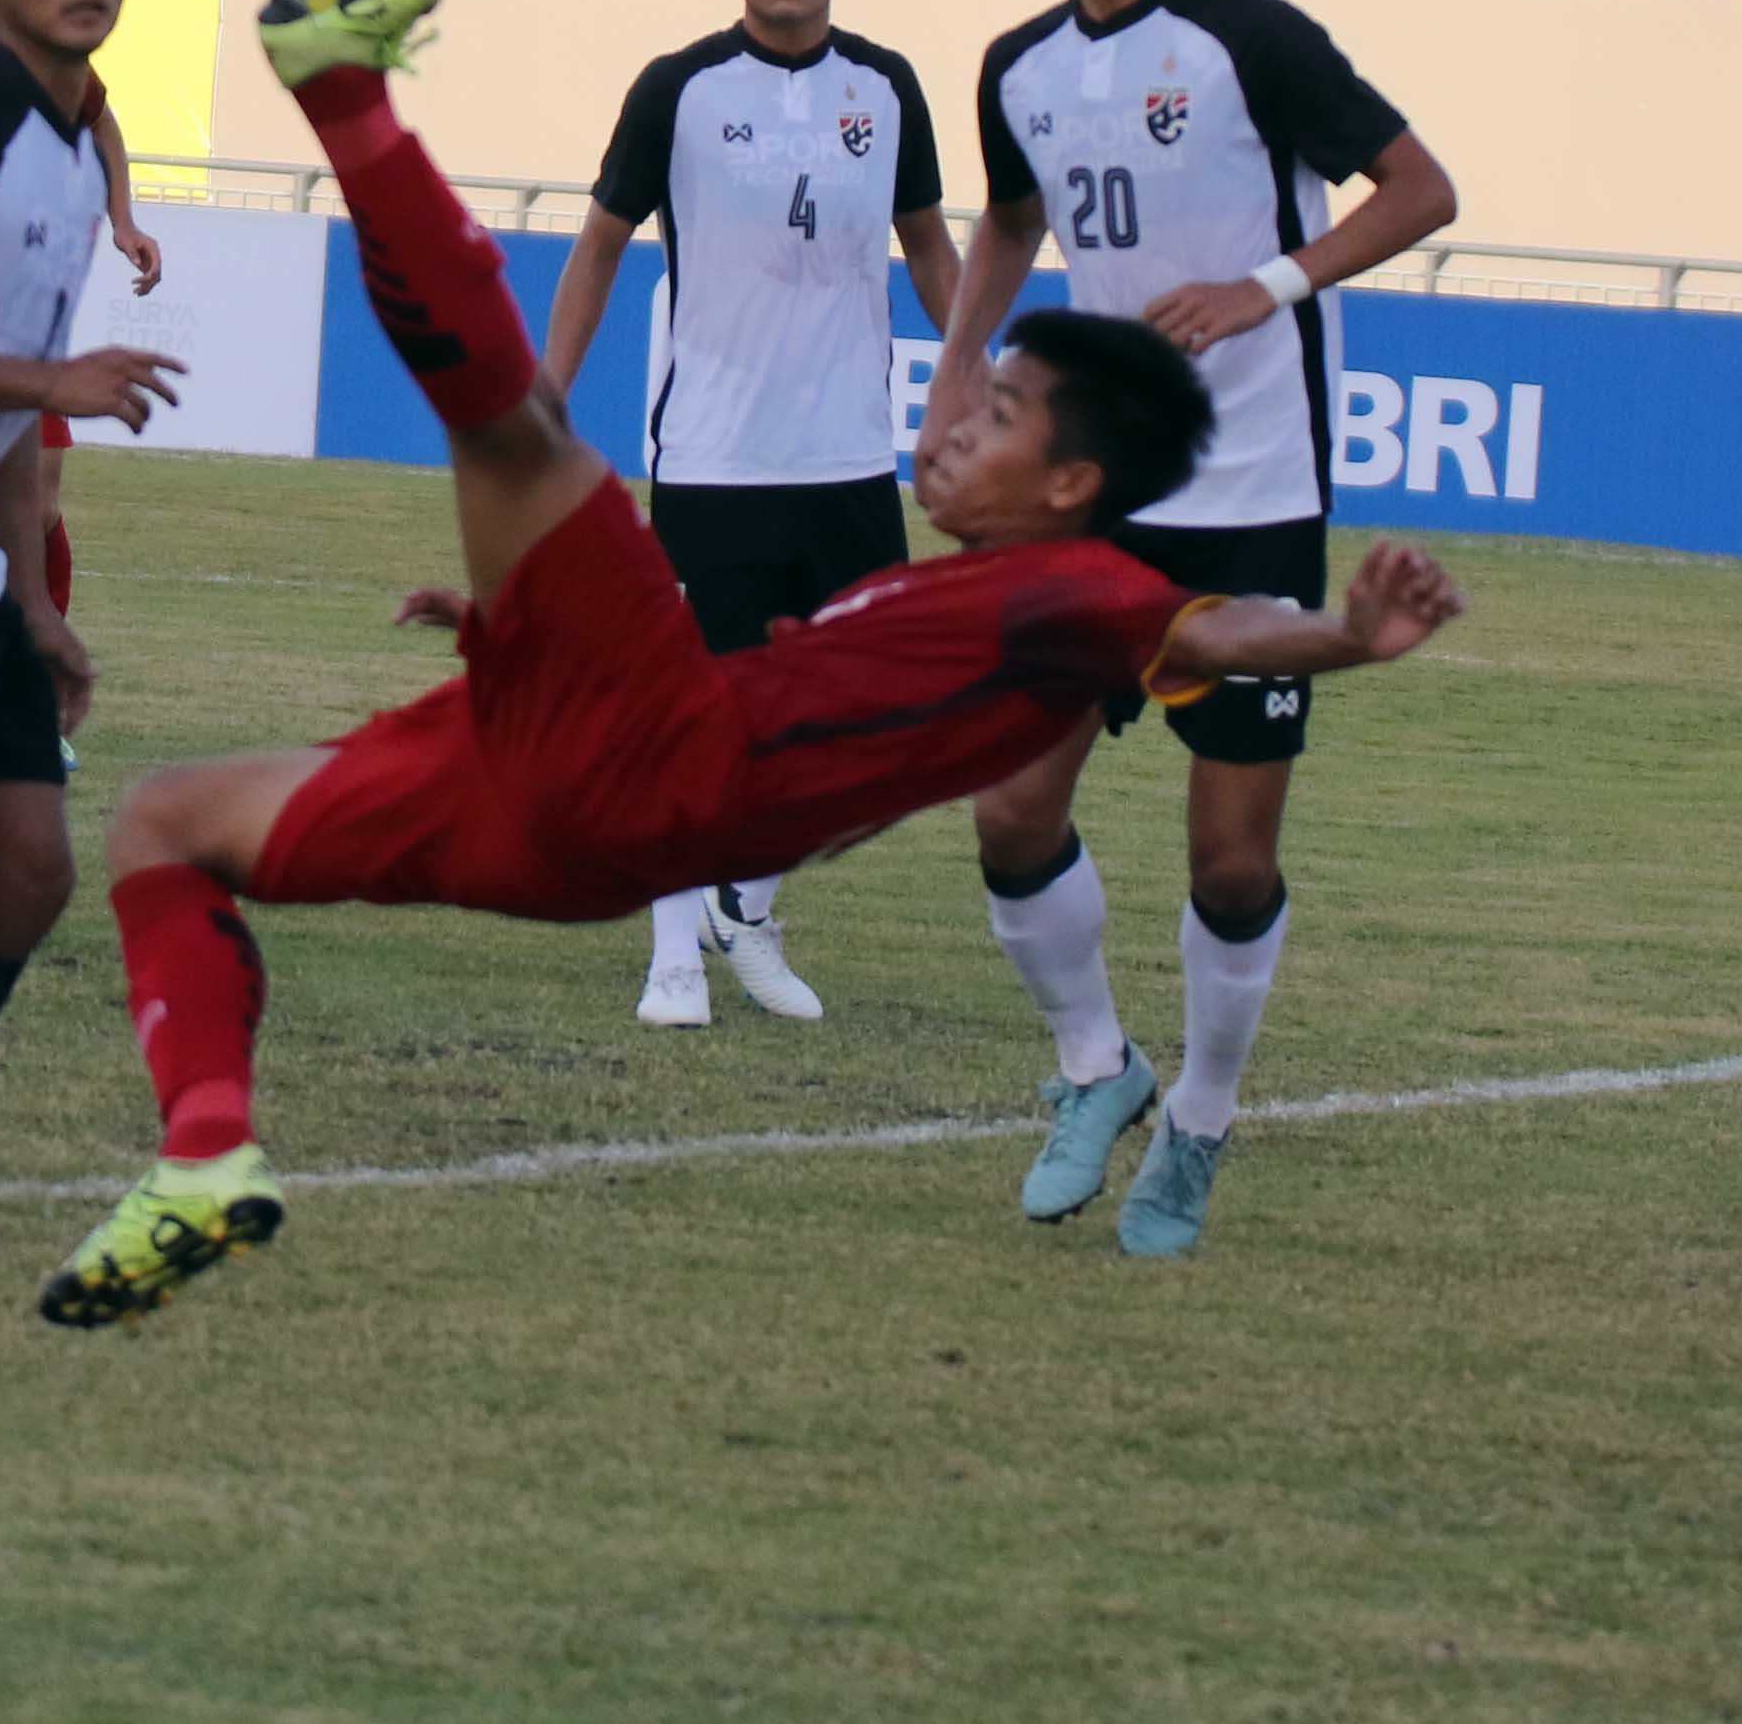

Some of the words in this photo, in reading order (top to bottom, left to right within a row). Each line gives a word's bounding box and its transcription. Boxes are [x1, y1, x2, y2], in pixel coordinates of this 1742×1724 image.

[787, 173, 816, 241] 4
[1068, 165, 1140, 249] 20
[1331, 369, 1544, 501] BRI
